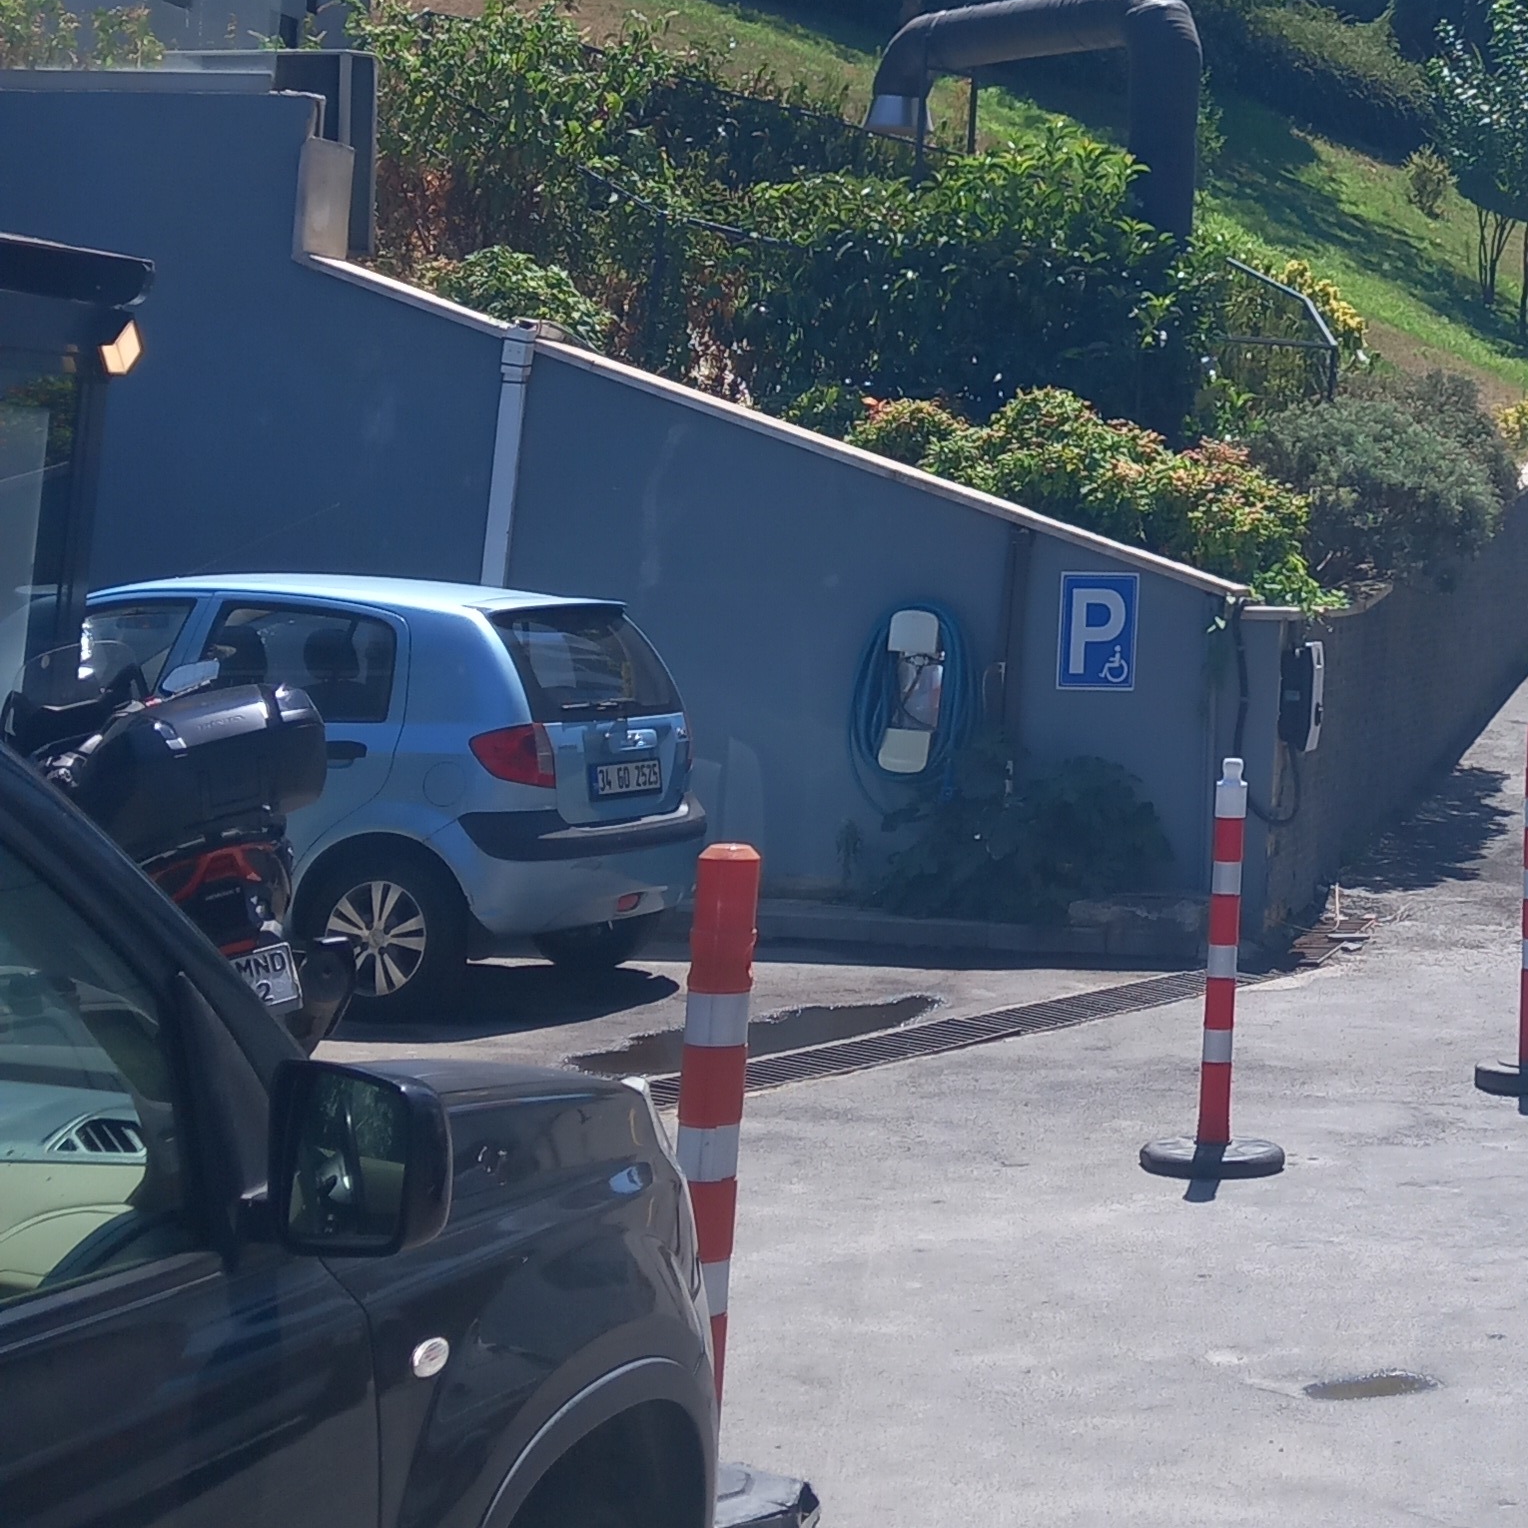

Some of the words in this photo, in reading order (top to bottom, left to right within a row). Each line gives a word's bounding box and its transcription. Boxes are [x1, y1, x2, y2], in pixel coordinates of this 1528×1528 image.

[1069, 587, 1126, 674] P
[599, 768, 612, 792] 34
[635, 764, 658, 787] 2525
[255, 979, 275, 1003] 2
